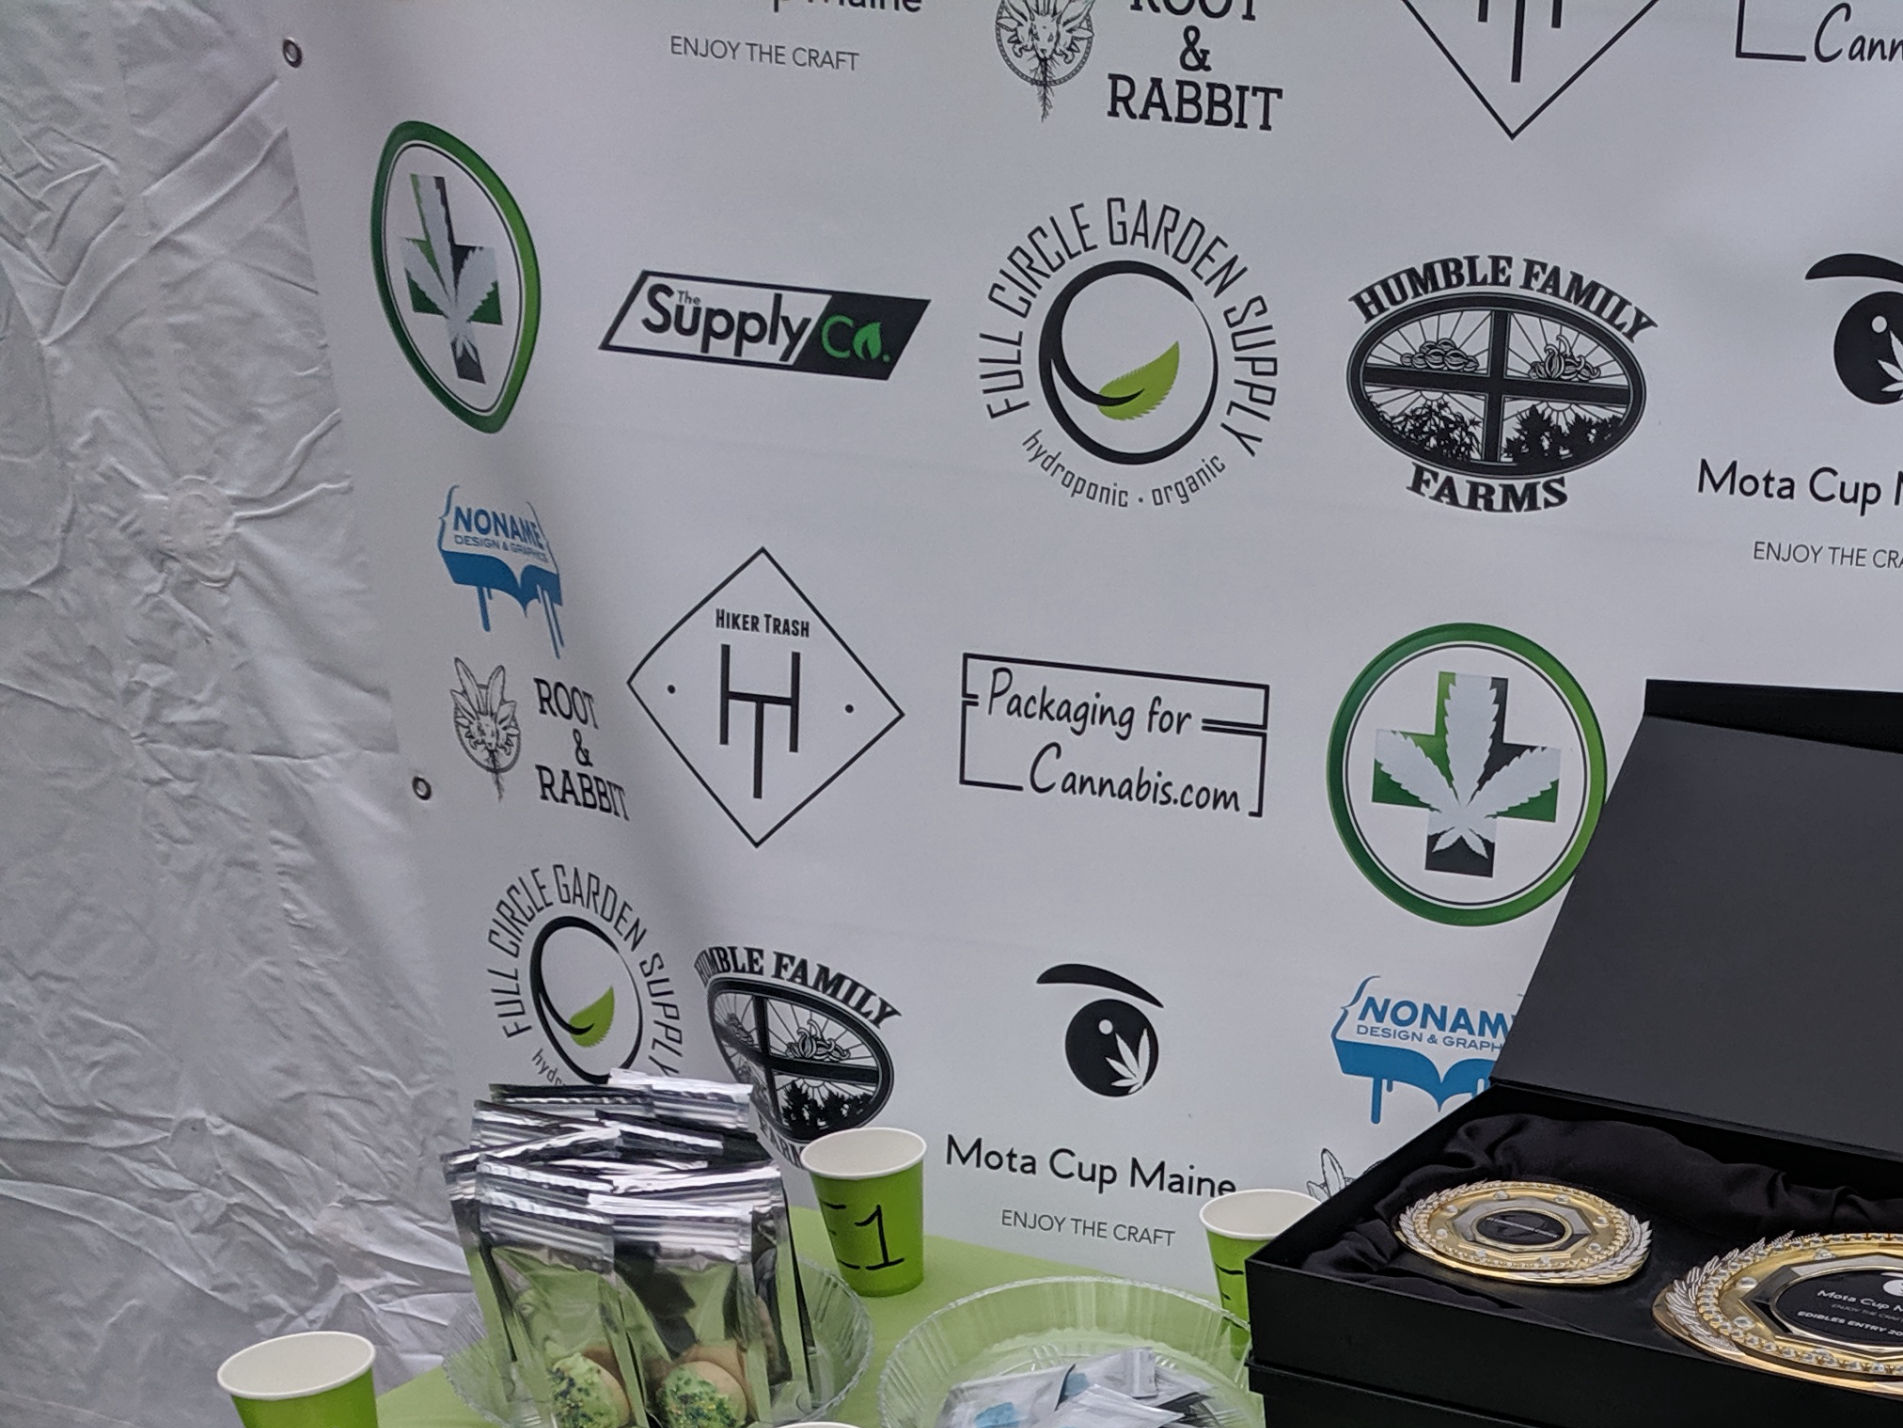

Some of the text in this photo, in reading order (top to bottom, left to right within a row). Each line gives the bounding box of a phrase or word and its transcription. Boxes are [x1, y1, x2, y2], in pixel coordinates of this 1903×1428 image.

[669, 35, 860, 72] ENJOY THE CRAFT
[1178, 25, 1212, 73] &
[1106, 73, 1283, 131] RABBIT
[641, 283, 812, 362] Supply
[676, 290, 702, 305] The
[1348, 255, 1658, 343] HUMBLE FAMILY
[979, 197, 1278, 457] FULL CIRCLE GARDEN SUPPLY
[1022, 429, 1226, 507] hydroponic organic
[1406, 462, 1568, 513] FARMS
[1698, 458, 1795, 500] Mota
[1808, 466, 1882, 516] Cup
[454, 506, 545, 551] NONAME
[1753, 541, 1823, 564] ENJOY
[1828, 546, 1867, 567] THE
[534, 677, 600, 730] ROOT
[987, 667, 1192, 740] Packaging for
[572, 728, 594, 767] &
[535, 764, 630, 821] RABBIT
[1030, 742, 1241, 812] Cannabis.com
[487, 868, 553, 958] CIRCLE
[553, 864, 647, 952] GARDEN
[487, 967, 532, 1038] FULL
[639, 953, 683, 1076] SUPPLY
[773, 951, 902, 1029] FAMILY
[1358, 996, 1515, 1039] NONAM
[1357, 1025, 1503, 1052] DESIGN & GRAPH
[945, 1133, 1237, 1198] Mota Cup Maine
[1000, 1209, 1176, 1248] ENJOY THE CRAFT
[1817, 1289, 1857, 1303] Mota
[1860, 1297, 1890, 1310] Cup
[1847, 1319, 1887, 1333] ENTRY
